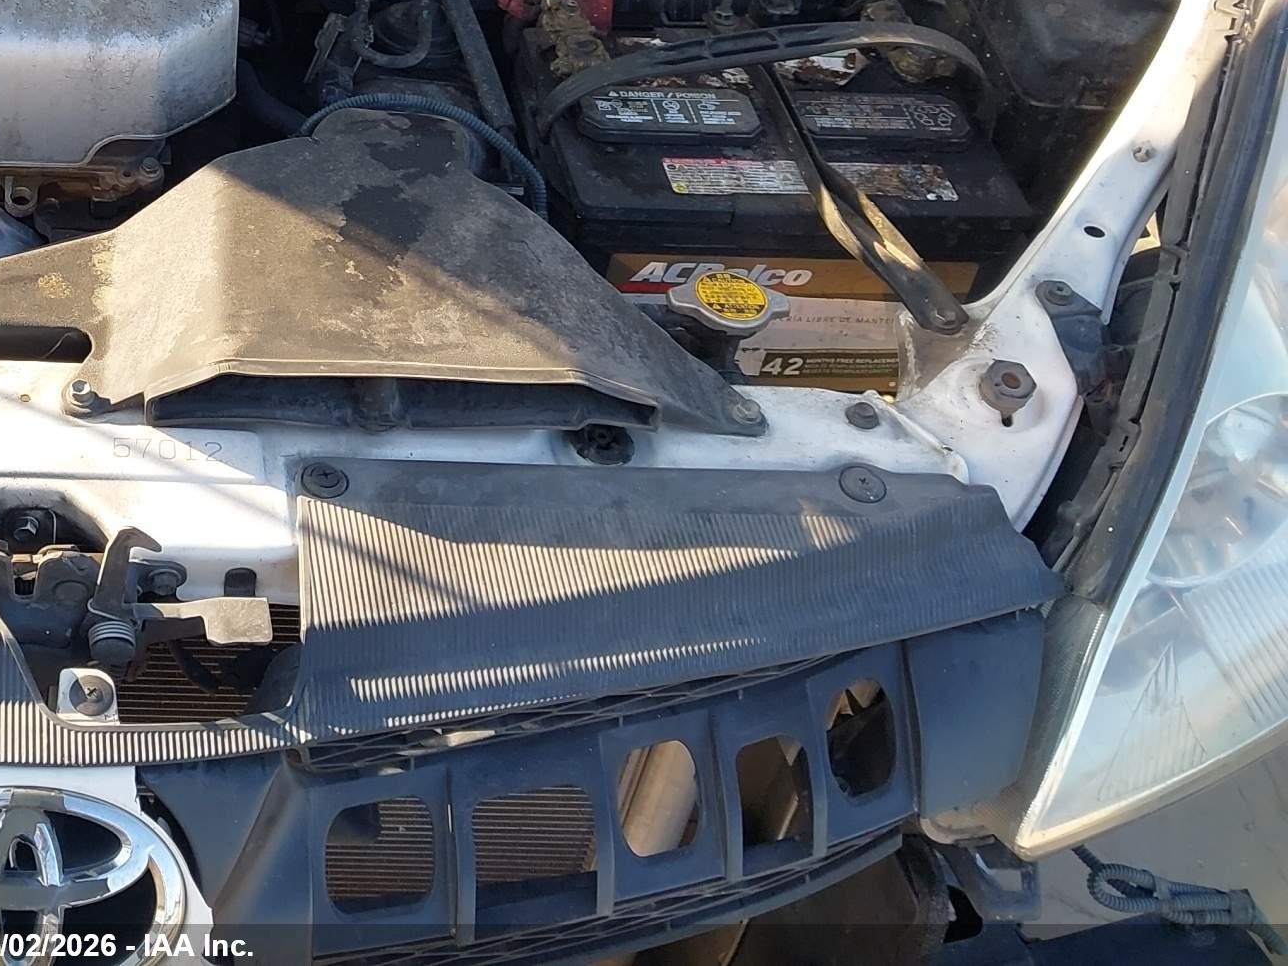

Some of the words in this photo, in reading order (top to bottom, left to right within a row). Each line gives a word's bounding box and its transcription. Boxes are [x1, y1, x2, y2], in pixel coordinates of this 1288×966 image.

[675, 92, 716, 100] POISON
[761, 357, 804, 376] 42
[112, 437, 223, 462] 57012
